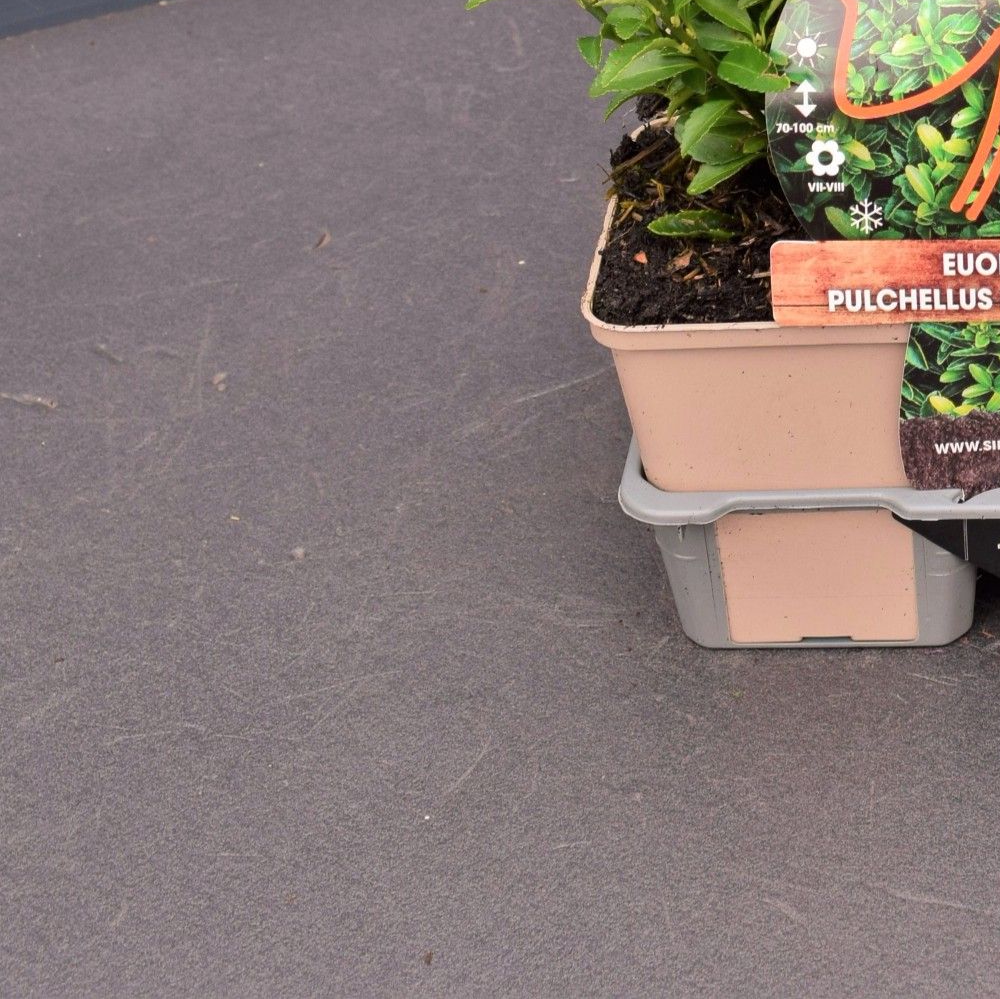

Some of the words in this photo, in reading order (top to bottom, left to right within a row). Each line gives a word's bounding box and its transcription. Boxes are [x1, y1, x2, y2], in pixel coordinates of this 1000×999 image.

[775, 123, 813, 134] 70-100
[816, 124, 835, 134] cm
[808, 182, 845, 193] VII-VIII
[827, 287, 993, 312] PULCHELLUS
